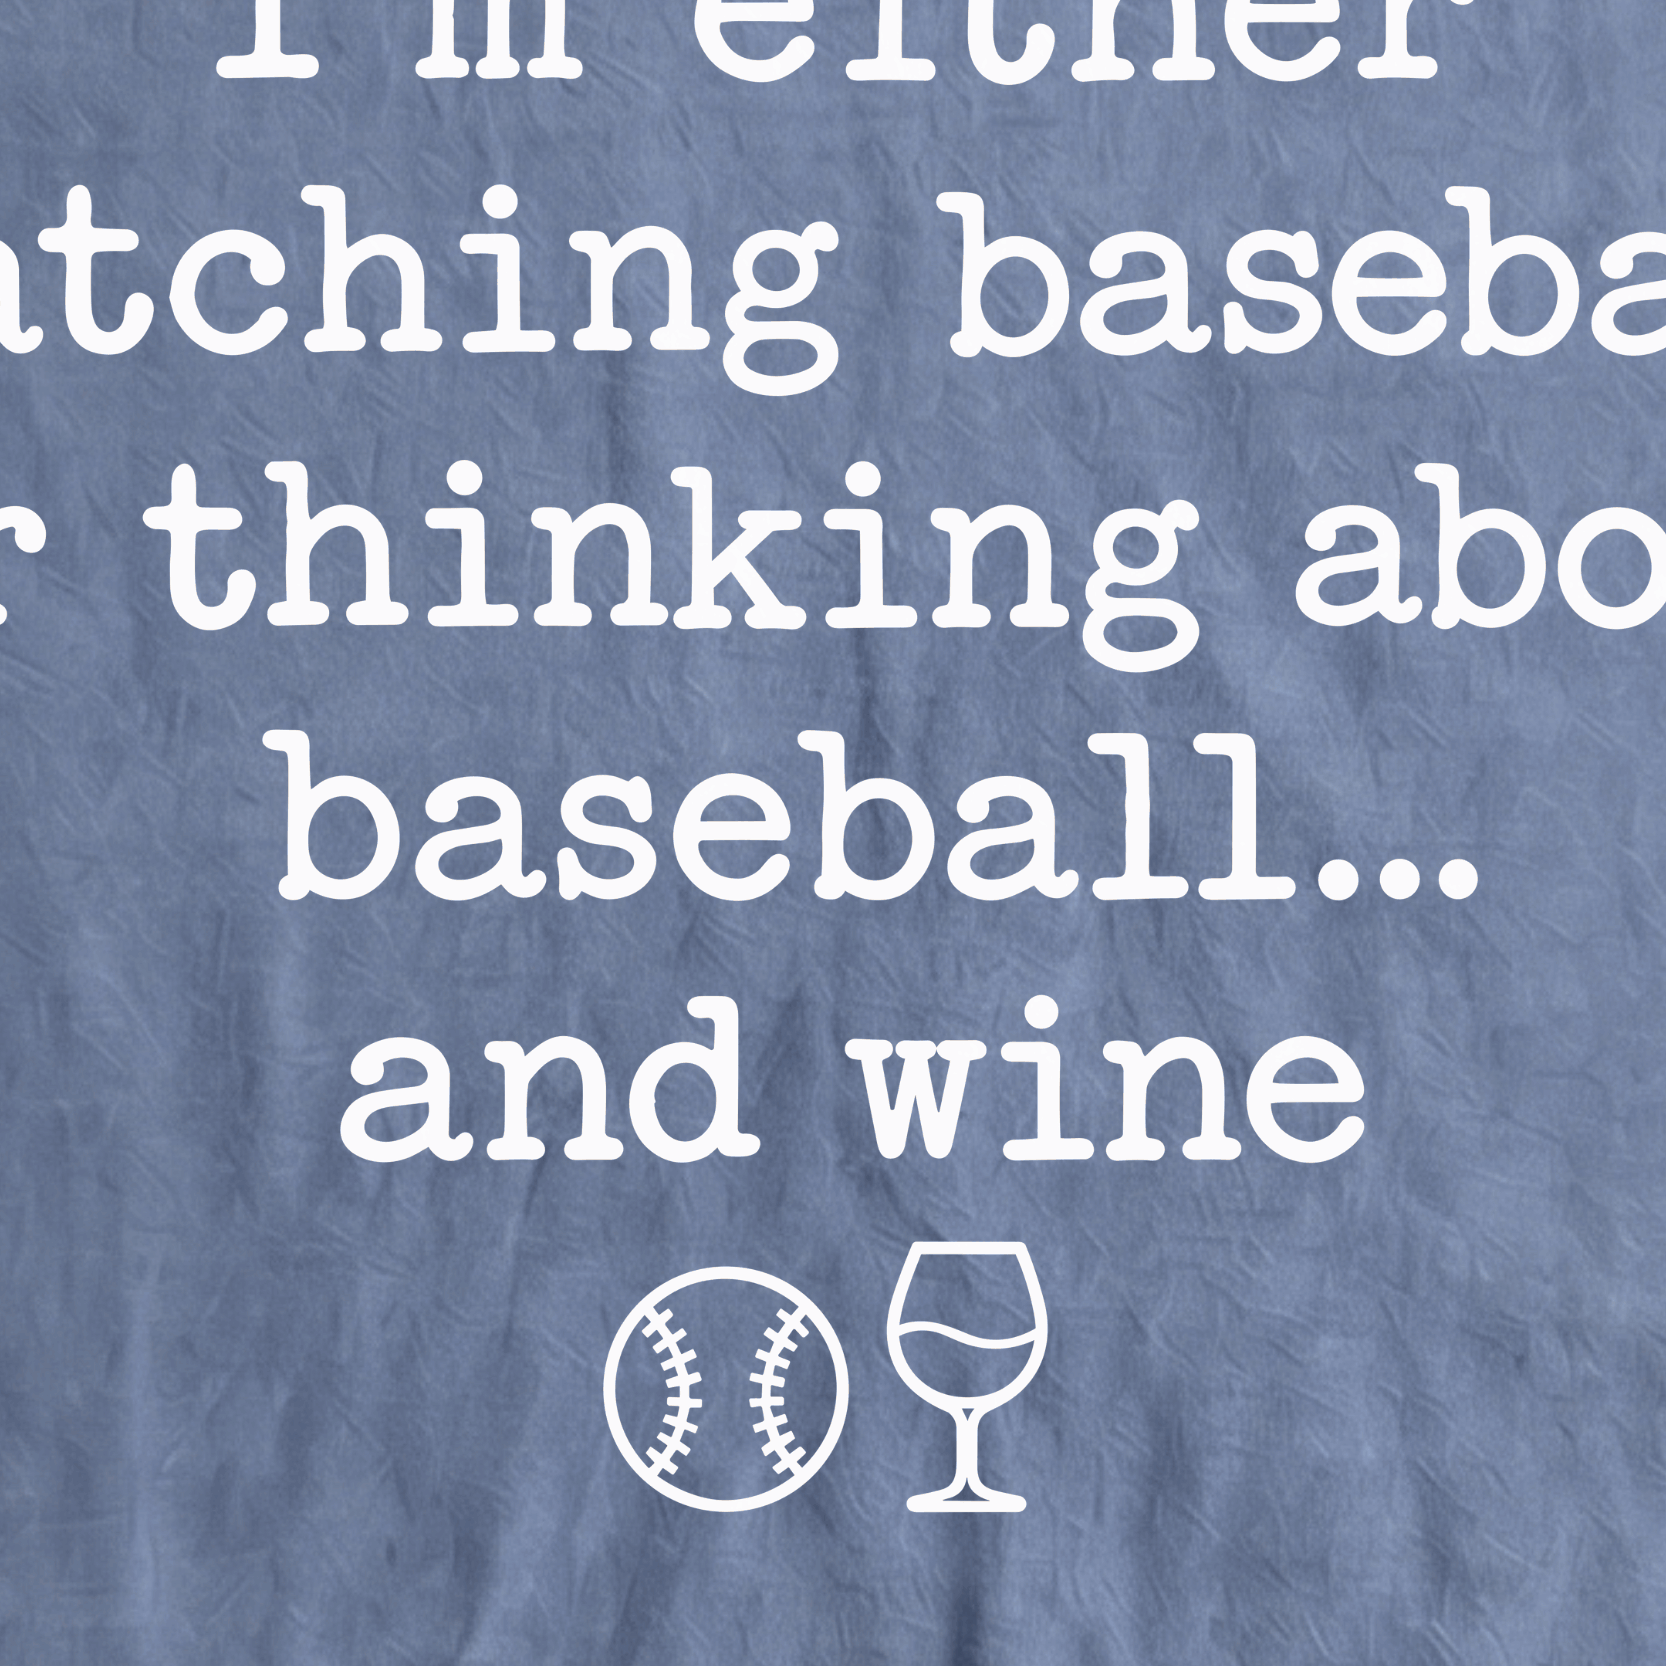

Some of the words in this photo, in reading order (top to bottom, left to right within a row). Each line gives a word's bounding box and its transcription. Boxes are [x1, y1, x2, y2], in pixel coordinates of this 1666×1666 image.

[141, 458, 1201, 674] thinking
[261, 728, 1479, 903] baseball...
[339, 994, 762, 1164] and
[843, 993, 1366, 1165] wine
